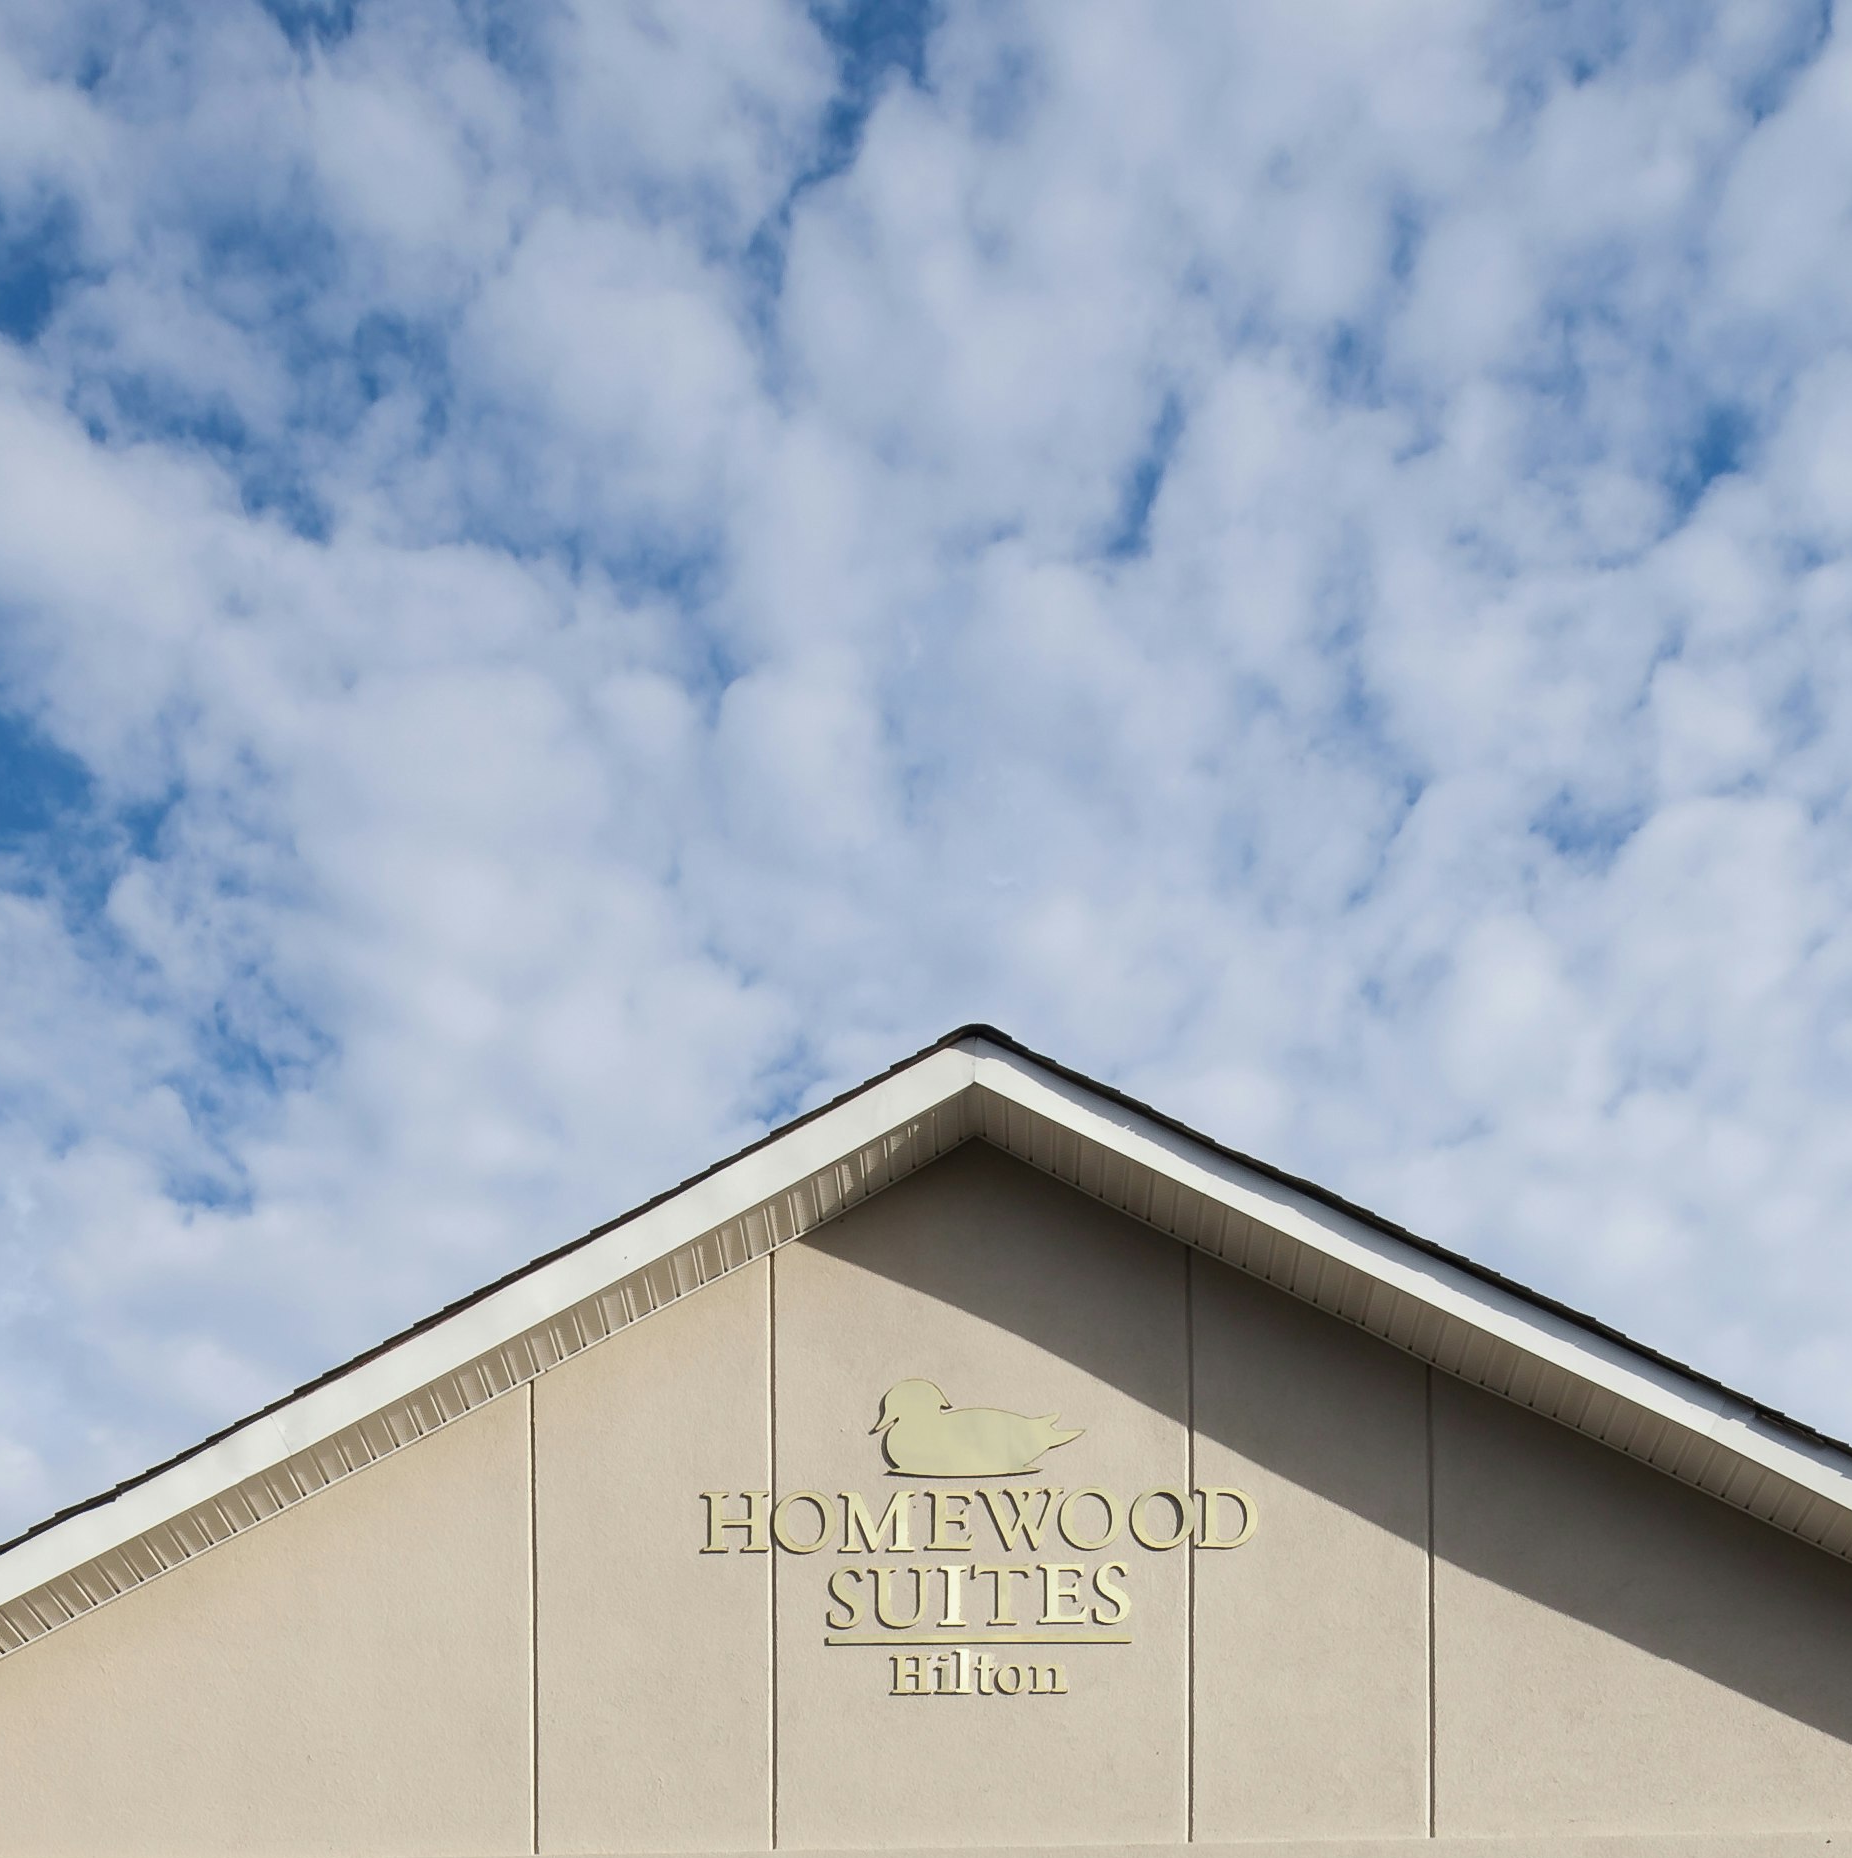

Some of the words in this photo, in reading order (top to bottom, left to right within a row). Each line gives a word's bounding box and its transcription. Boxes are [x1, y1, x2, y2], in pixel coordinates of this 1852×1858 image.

[699, 1486, 1259, 1554] HOMEWOOD
[826, 1561, 1132, 1629] SUITES
[889, 1648, 1068, 1695] Hilton
